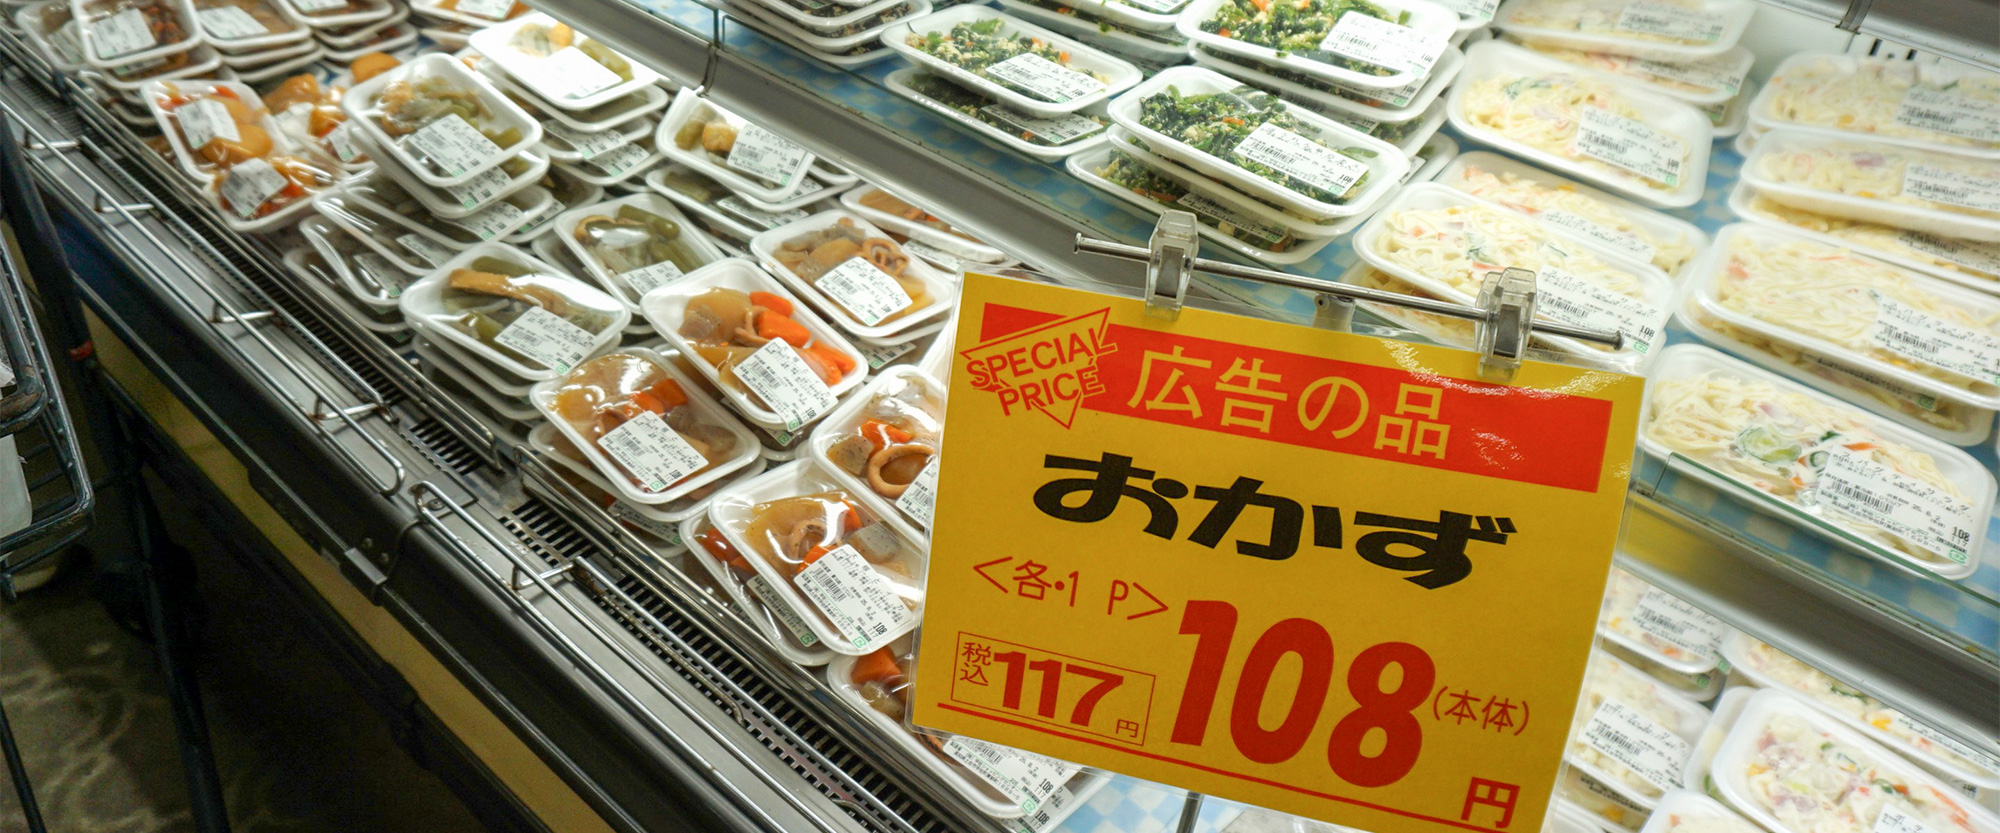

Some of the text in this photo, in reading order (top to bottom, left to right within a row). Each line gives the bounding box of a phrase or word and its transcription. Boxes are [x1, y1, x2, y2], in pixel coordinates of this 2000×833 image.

[967, 327, 1118, 389] SPECIAL
[998, 364, 1105, 417] PRICE
[1126, 345, 1451, 460] 広告の品
[1033, 451, 1517, 590] おかず
[1950, 526, 1971, 542] 108
[871, 620, 889, 637] 108
[959, 642, 992, 687] 税込
[993, 651, 1139, 738] 117 円
[1170, 600, 1530, 788] 108 (本体)
[1038, 777, 1055, 793] 108
[1460, 776, 1521, 829] 円
[1033, 808, 1051, 825] 108
